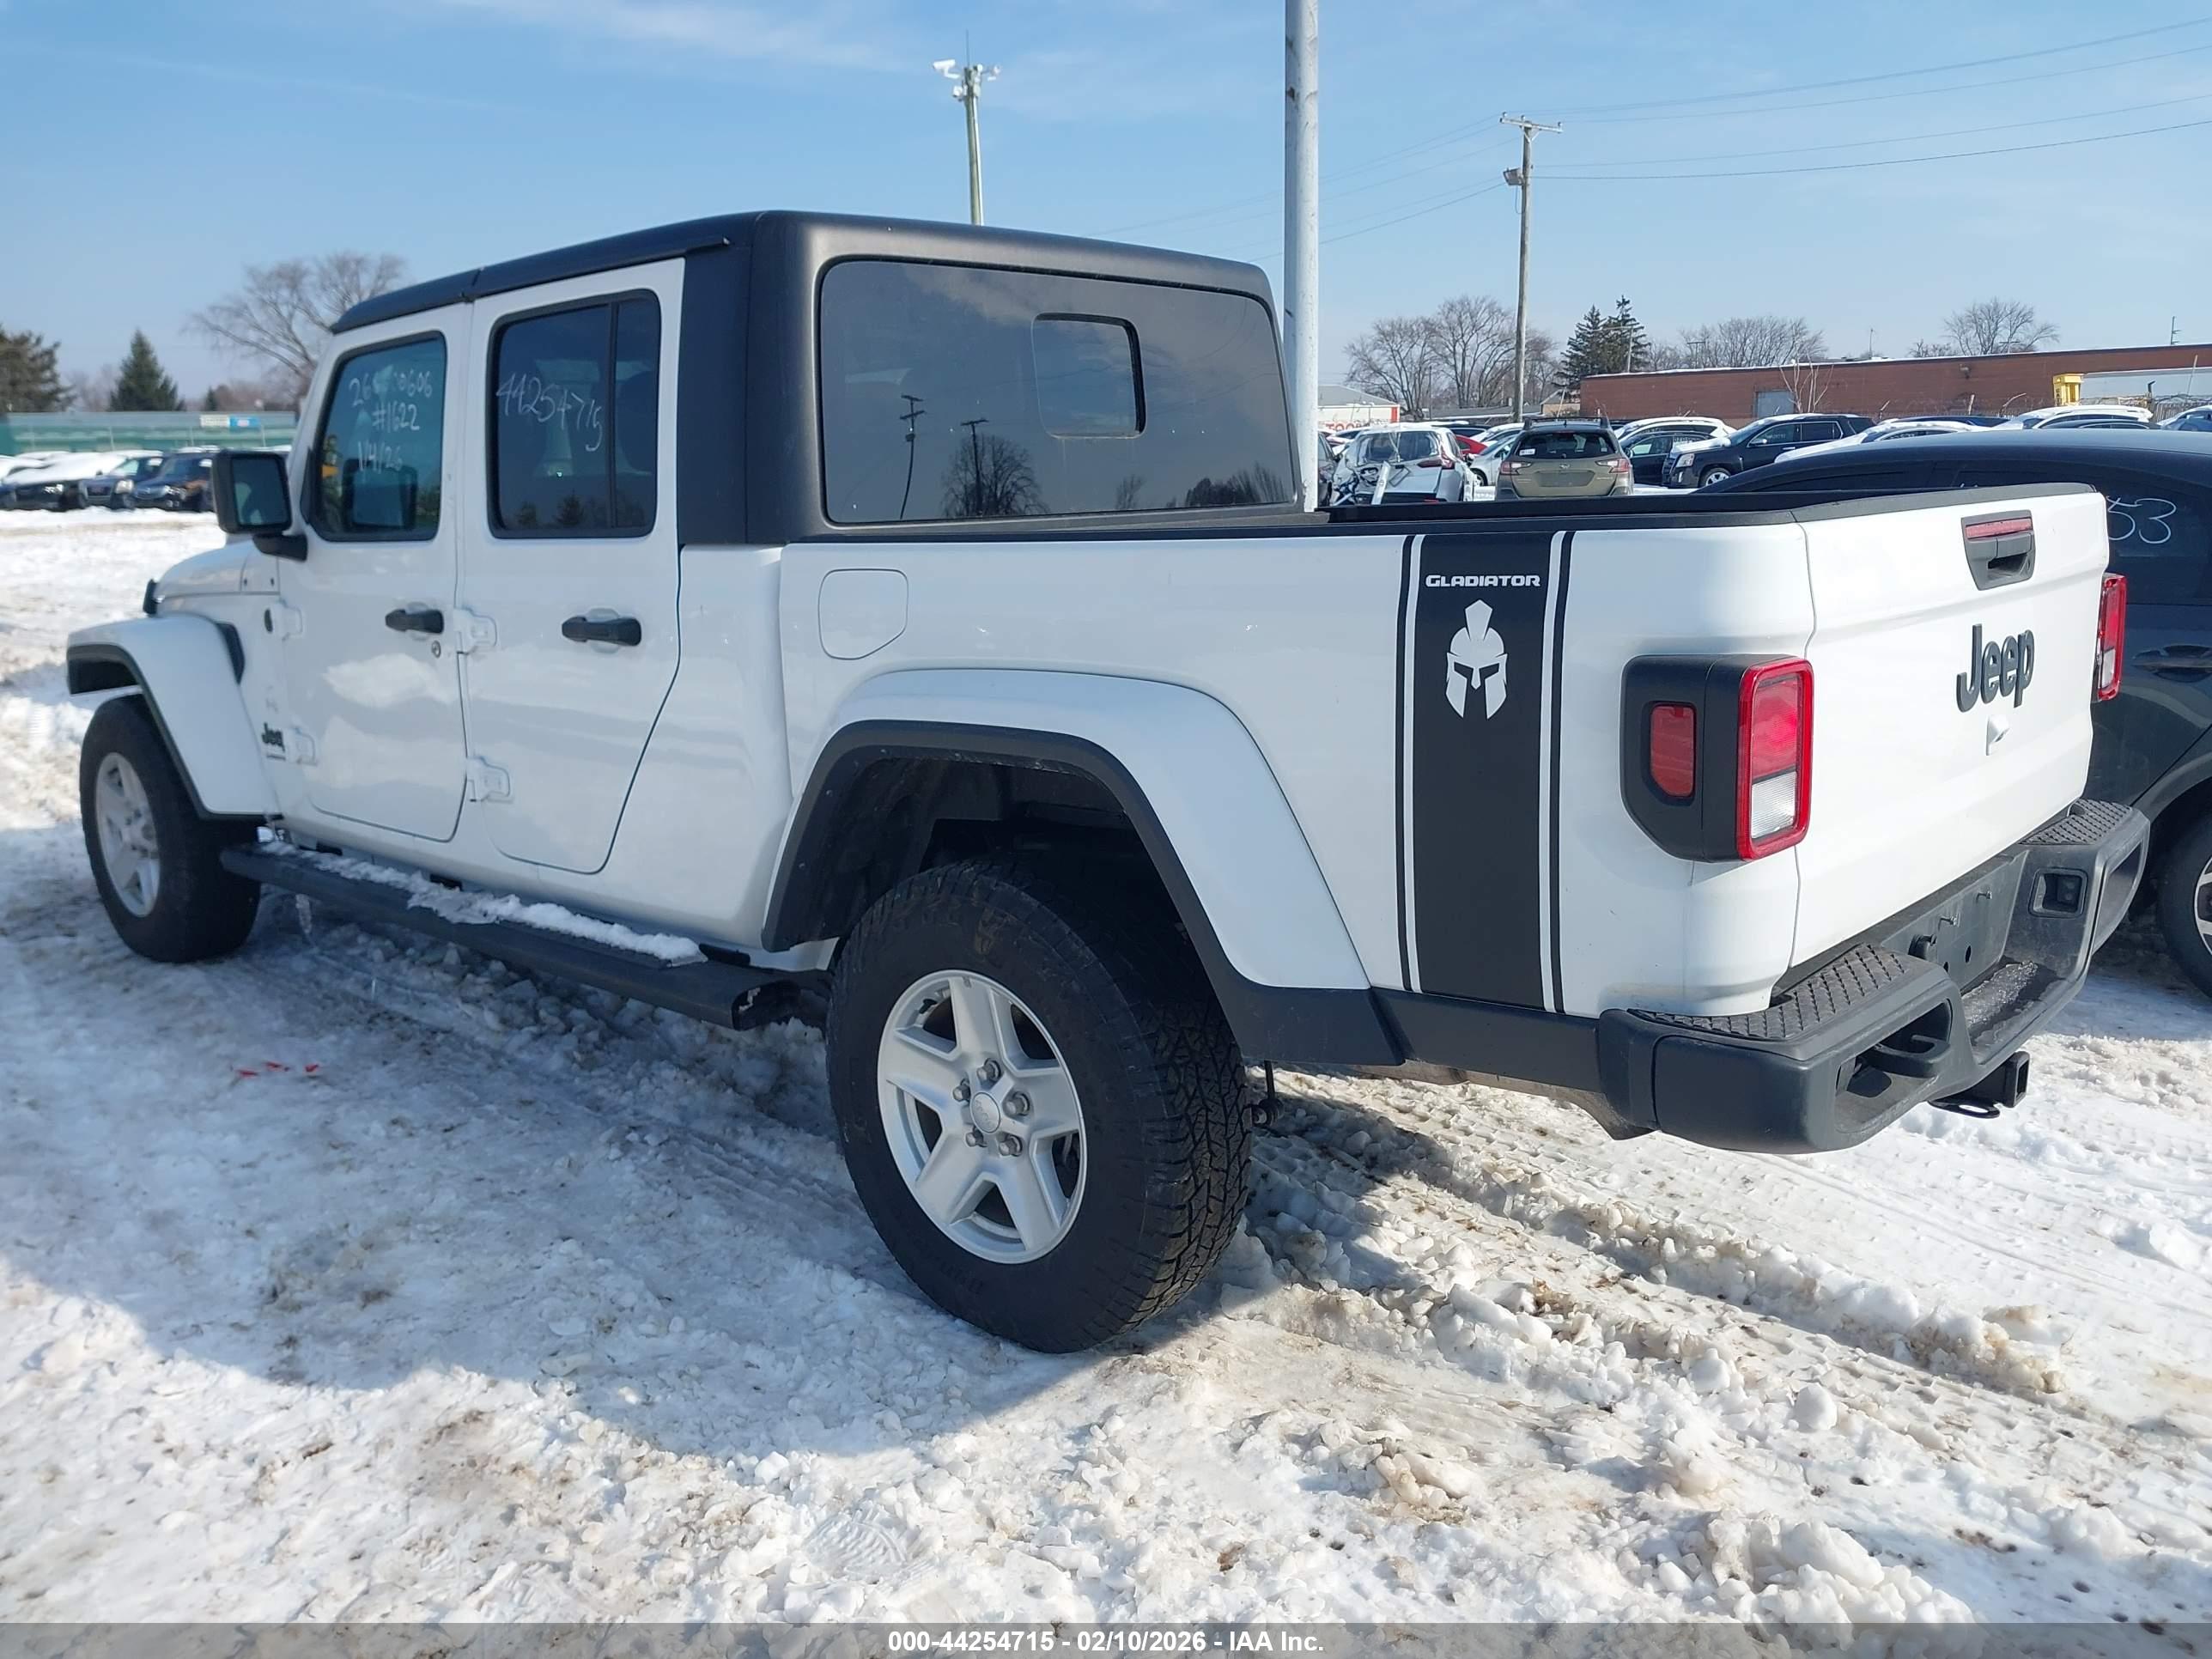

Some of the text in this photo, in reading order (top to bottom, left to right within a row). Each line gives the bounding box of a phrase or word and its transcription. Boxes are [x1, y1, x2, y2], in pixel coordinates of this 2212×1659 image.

[371, 400, 420, 433] #1622
[496, 373, 603, 452] 44254715
[1425, 574, 1540, 587] GLADIATOR
[1956, 623, 2035, 713] Jeep
